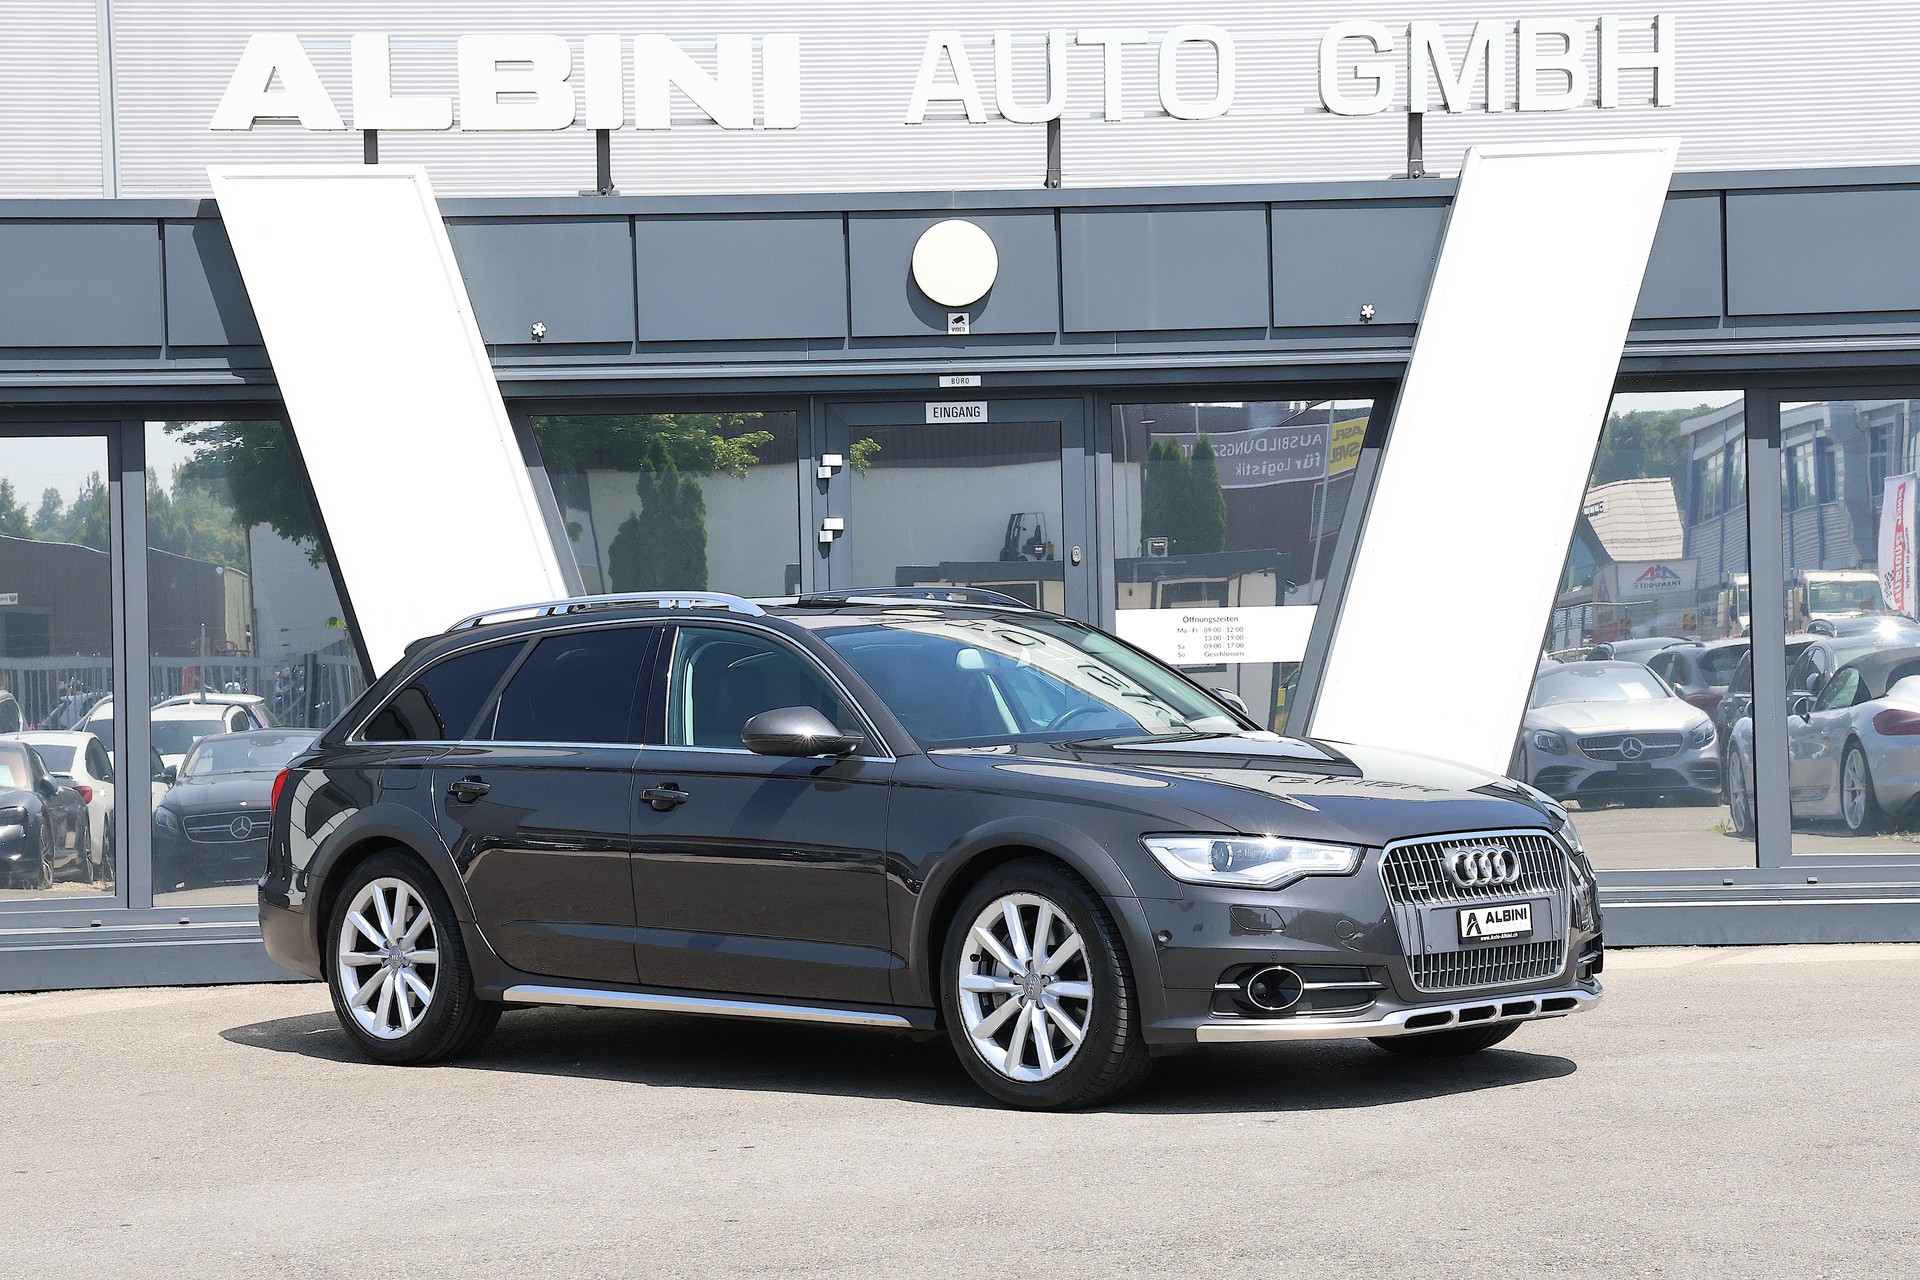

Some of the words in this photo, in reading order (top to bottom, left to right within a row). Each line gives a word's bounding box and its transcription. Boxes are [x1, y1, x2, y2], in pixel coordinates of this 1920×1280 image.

[208, 33, 800, 131] ALBINI
[904, 24, 1236, 125] AUTO
[1318, 14, 1677, 117] GMBH
[951, 377, 970, 385] BÜRO
[933, 406, 981, 418] EINGANG
[1182, 615, 1239, 624] Öffnungszeiten
[1485, 907, 1528, 924] ALBINI
